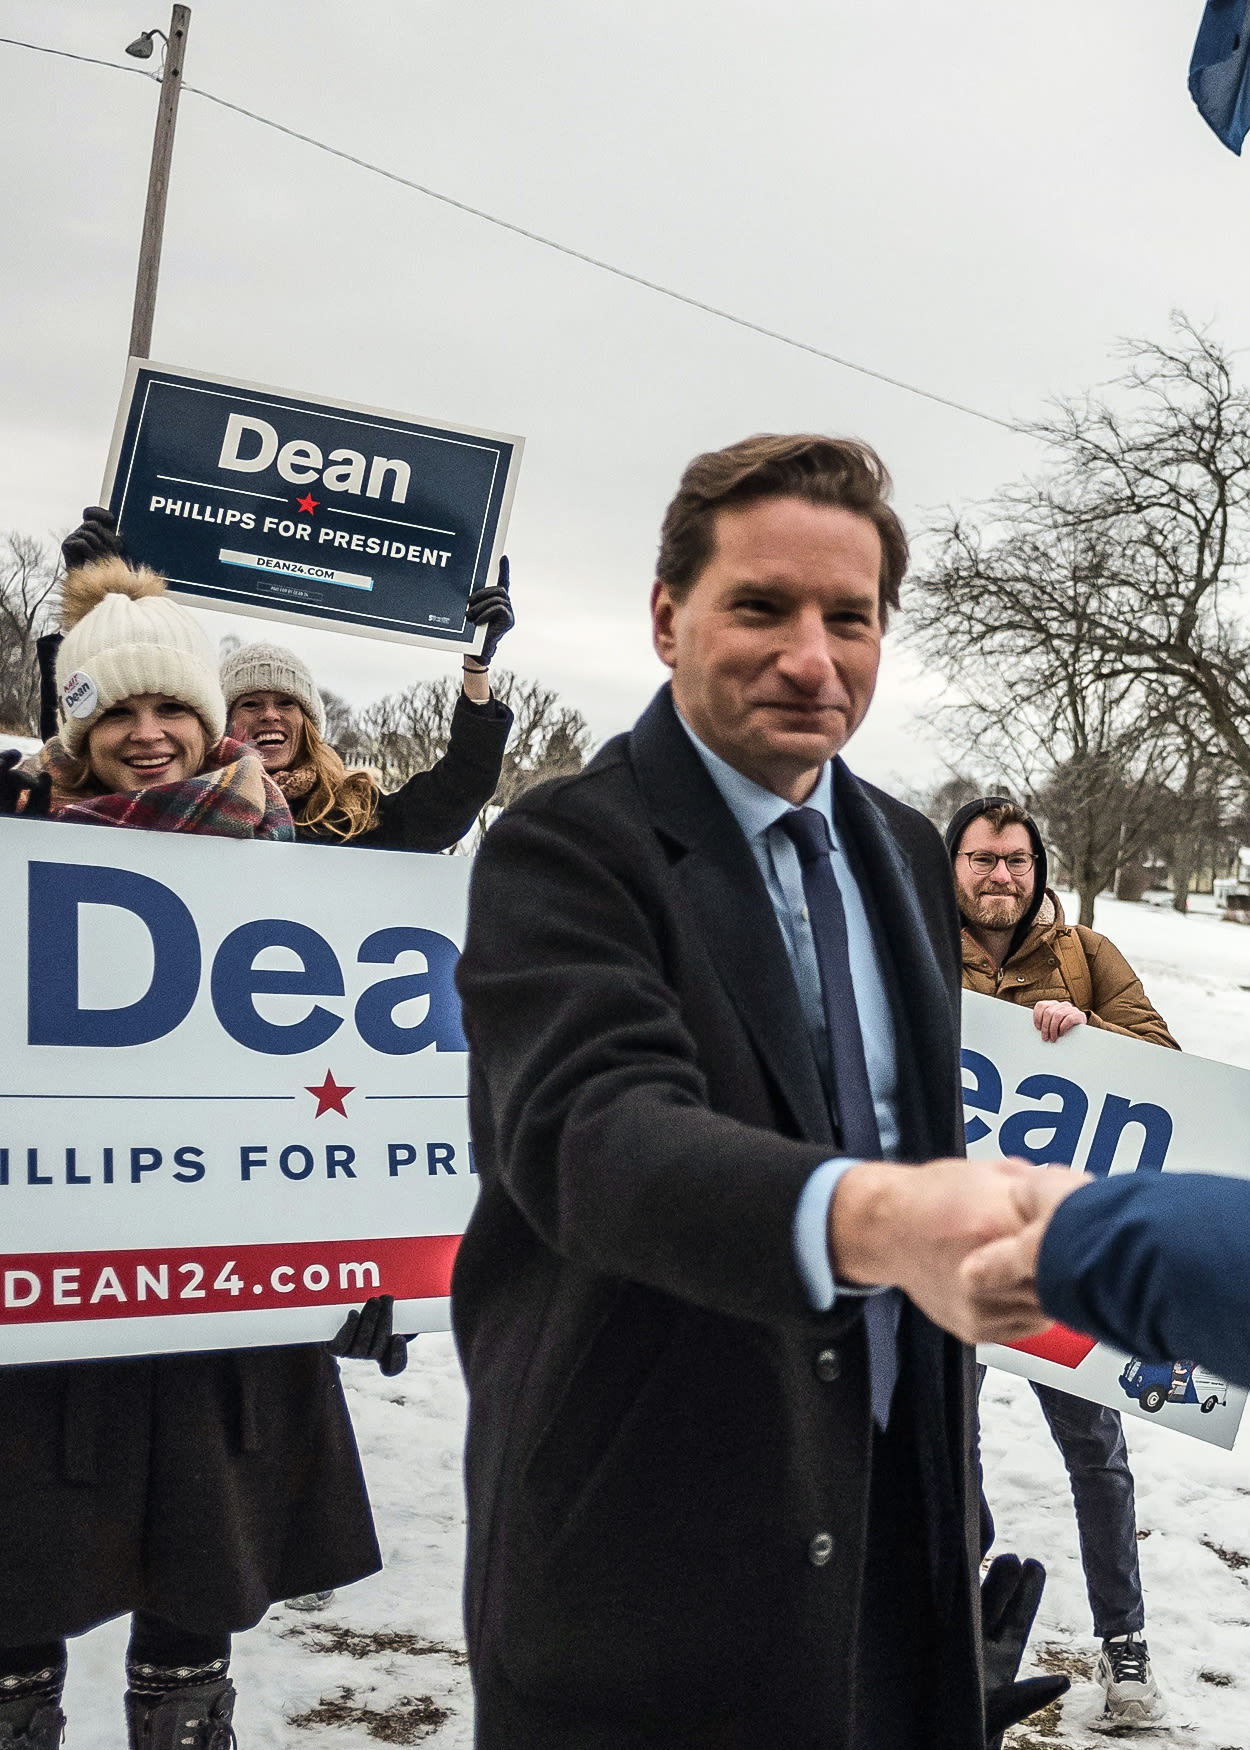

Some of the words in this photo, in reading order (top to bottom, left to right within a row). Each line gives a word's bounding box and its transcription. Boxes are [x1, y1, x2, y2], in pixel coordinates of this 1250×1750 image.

[218, 413, 412, 504] Dean
[149, 495, 257, 531] PHILLIPS
[263, 516, 311, 541] FOR
[318, 527, 452, 568] PRESIDENT
[256, 556, 335, 580] DEAN24.COM
[65, 682, 90, 708] Dean
[28, 861, 470, 1056] Dea
[241, 1145, 356, 1181] FOR
[4, 1260, 381, 1308] DEAN24.com
